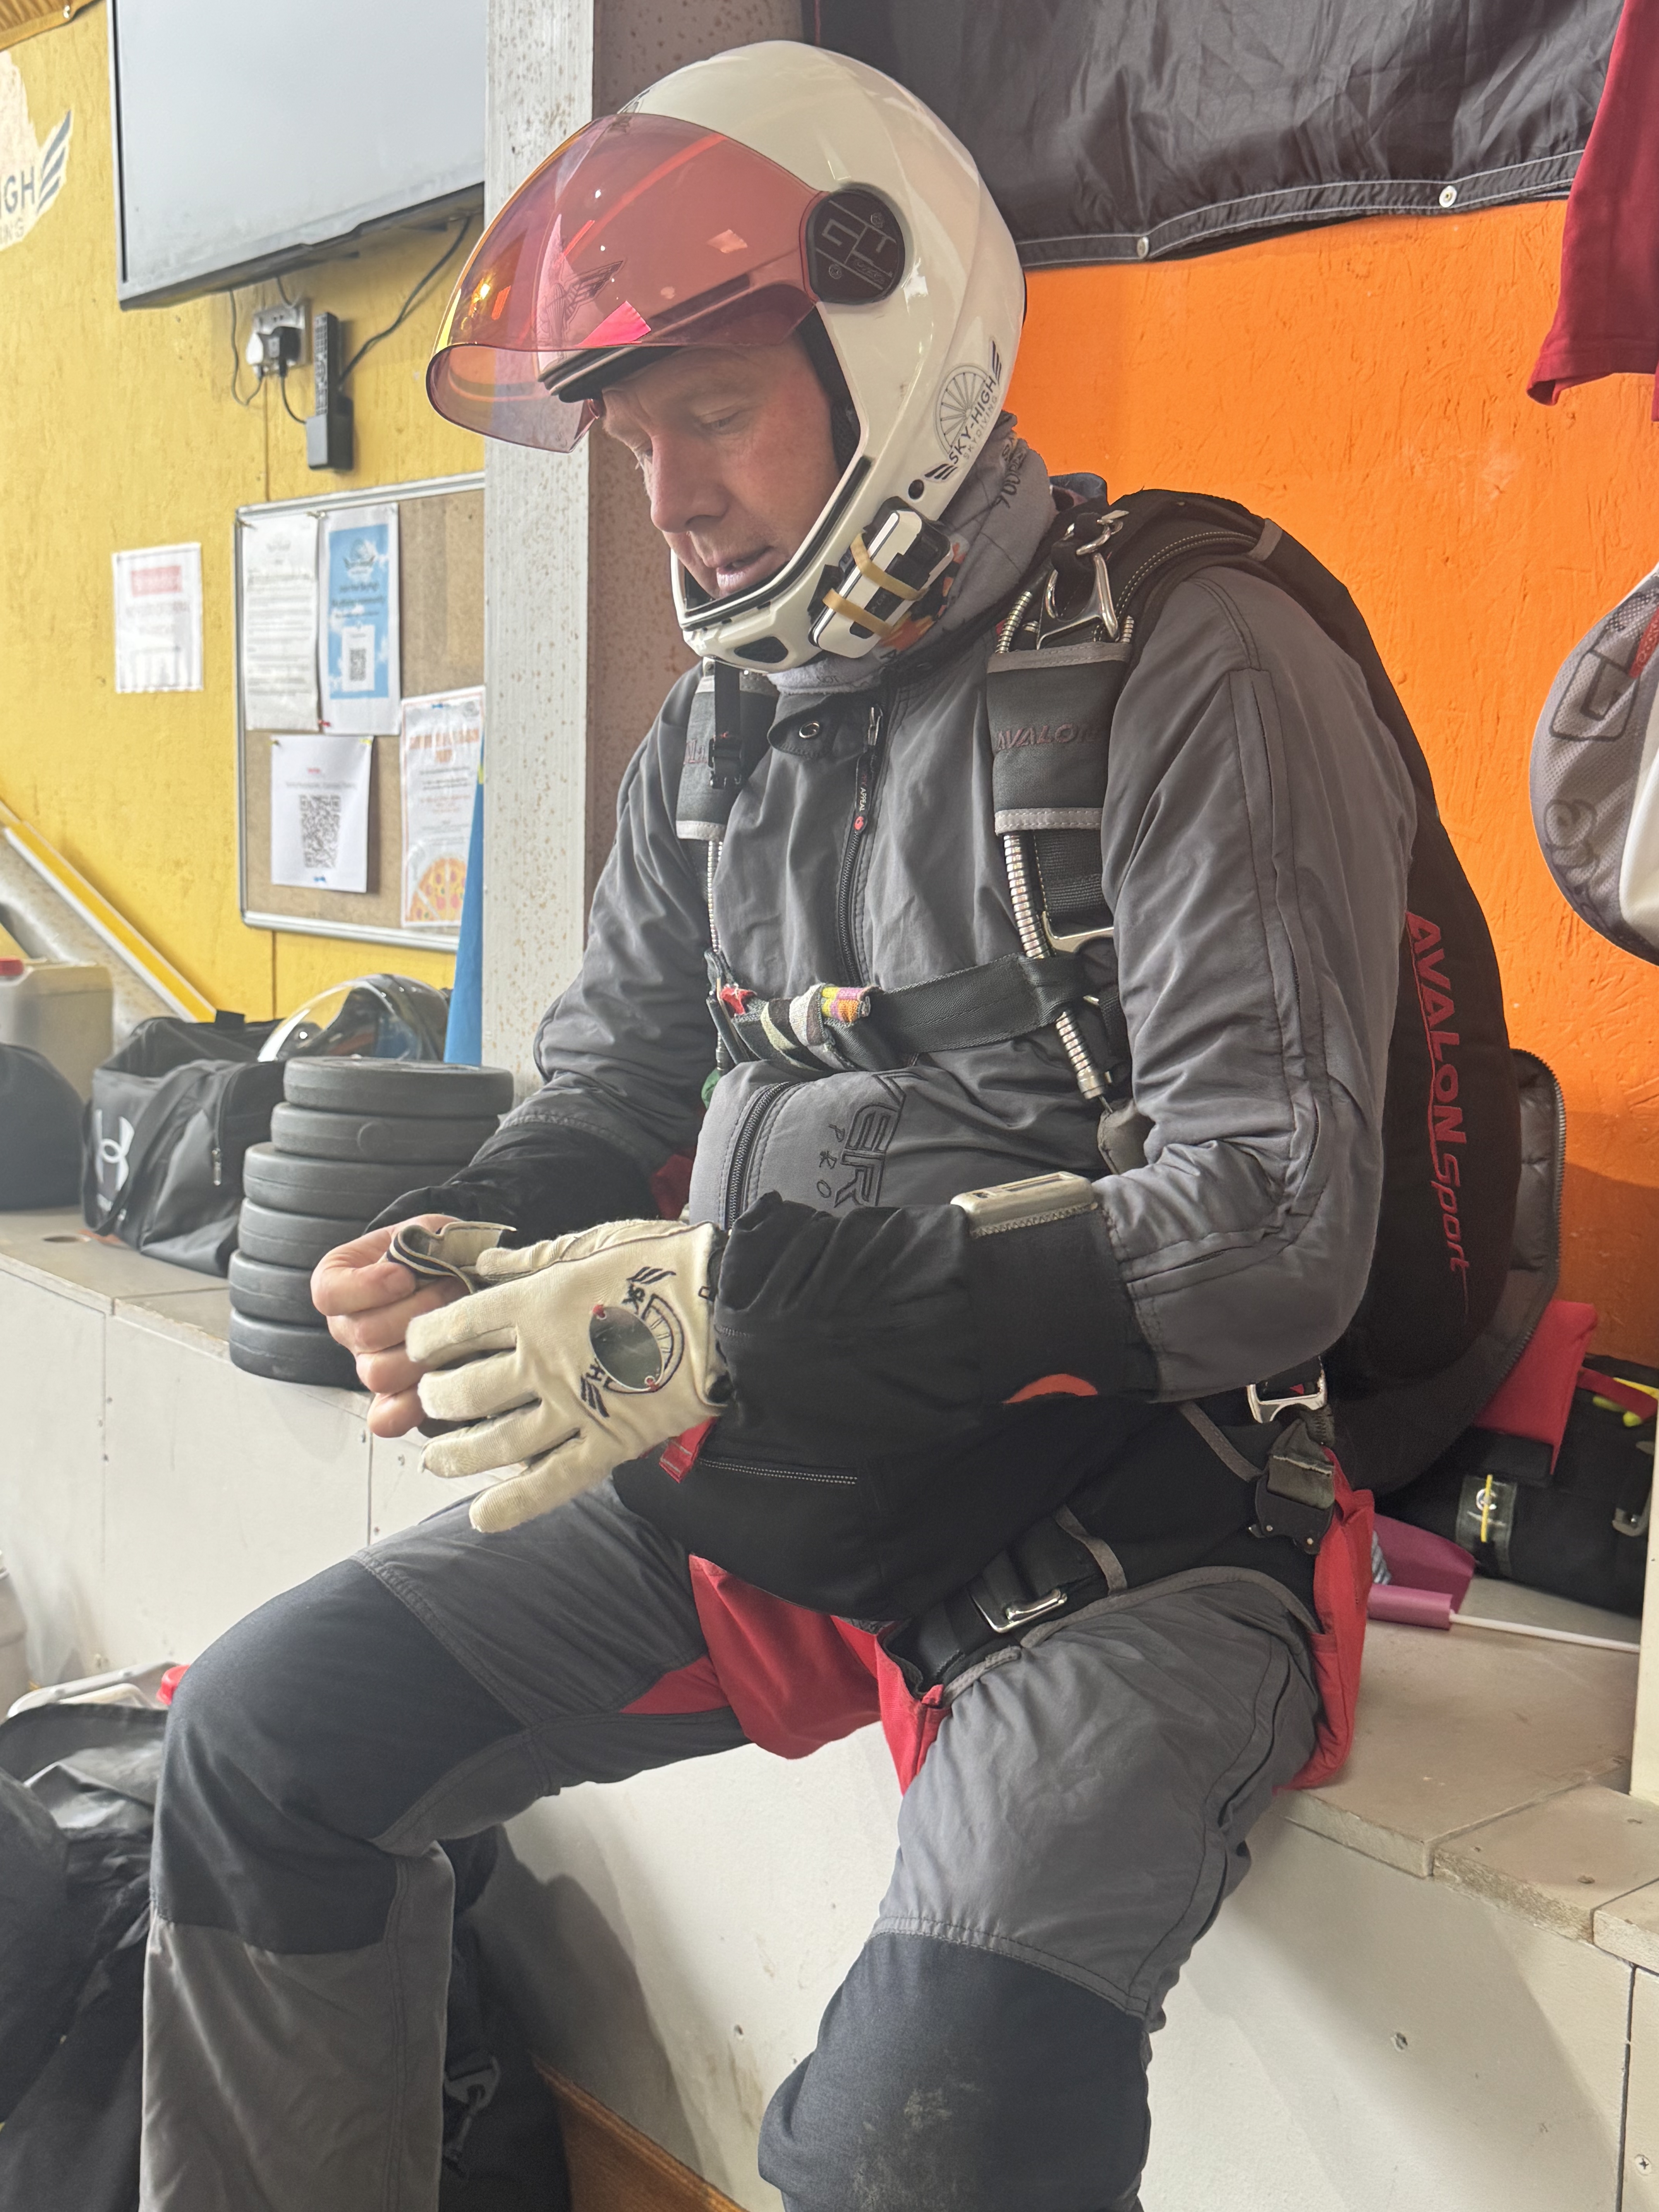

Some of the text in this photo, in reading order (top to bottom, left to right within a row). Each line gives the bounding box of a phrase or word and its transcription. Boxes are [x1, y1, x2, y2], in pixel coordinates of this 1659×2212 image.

[0, 167, 34, 213] GH
[949, 375, 996, 464] SKY-HIGH
[963, 396, 998, 460] SKYDIVING
[1406, 910, 1467, 1144] AVALON
[816, 1123, 846, 1199] PRO
